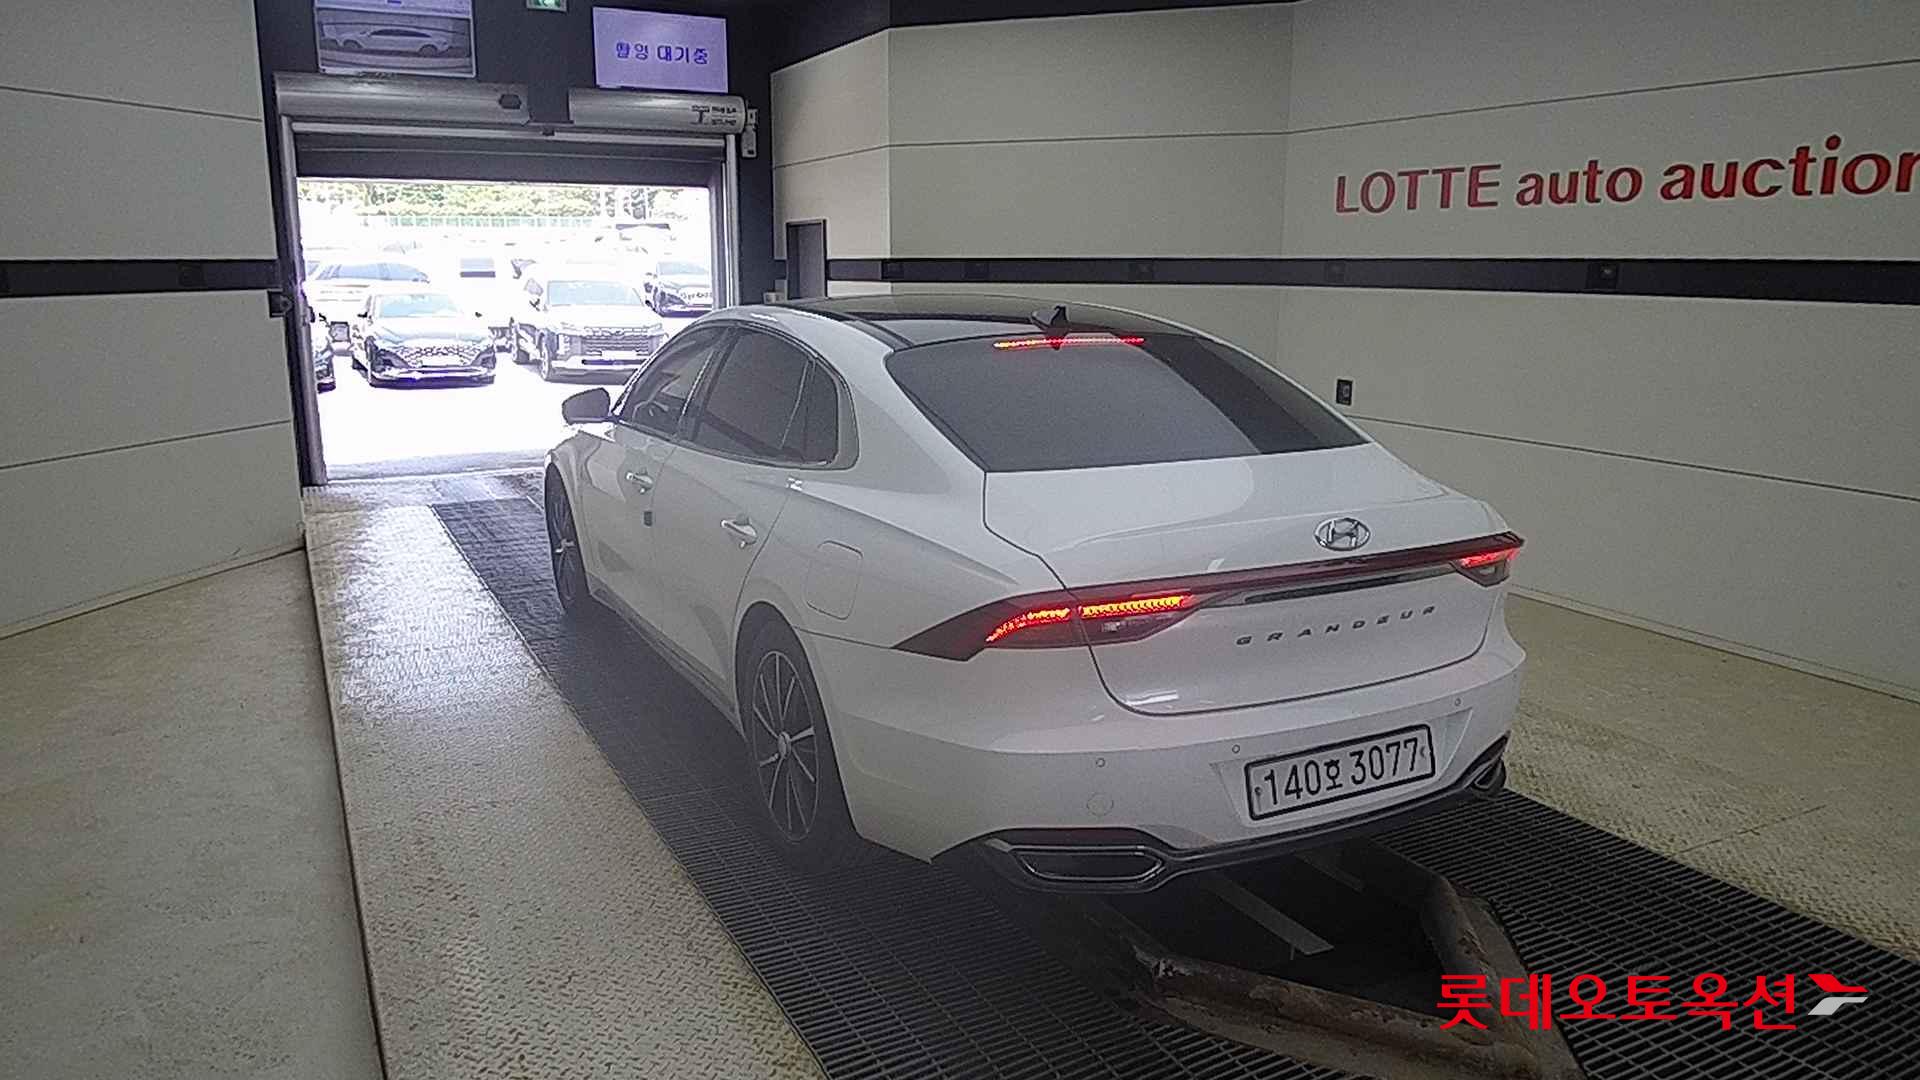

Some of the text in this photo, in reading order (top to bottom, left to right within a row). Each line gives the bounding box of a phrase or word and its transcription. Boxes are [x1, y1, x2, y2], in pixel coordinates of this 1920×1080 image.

[656, 45, 709, 65] 대기중
[1335, 164, 1501, 213] LOTTE
[1516, 159, 1643, 206] auto
[1236, 605, 1436, 646] GRANDEUR
